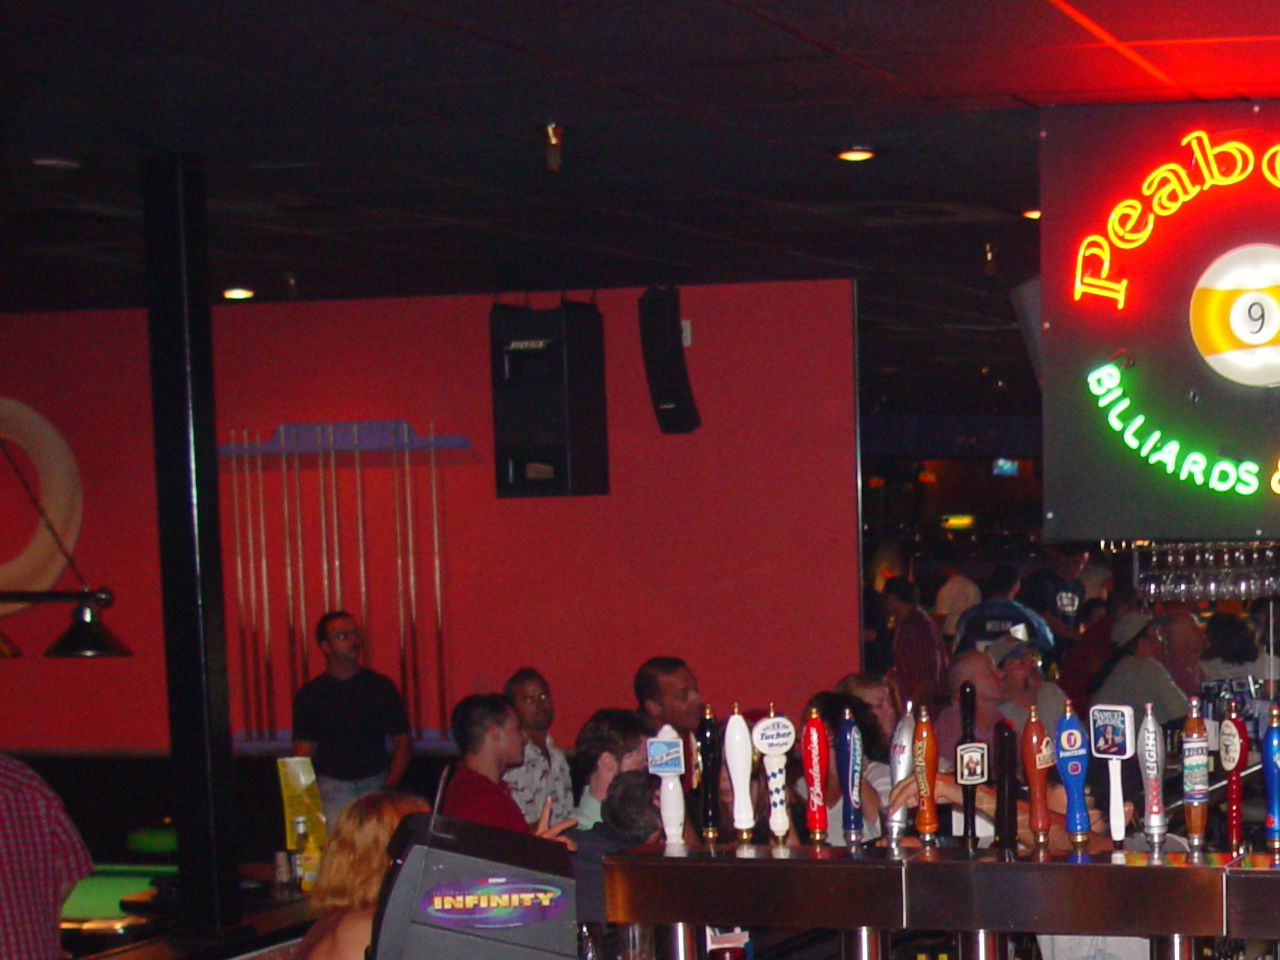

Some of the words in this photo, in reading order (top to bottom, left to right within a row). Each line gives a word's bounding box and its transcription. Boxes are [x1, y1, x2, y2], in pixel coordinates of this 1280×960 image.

[1246, 301, 1267, 335] 9
[1087, 364, 1260, 494] BILLIARDS
[808, 727, 824, 811] Budweiser
[1144, 728, 1158, 776] LIGHT
[433, 892, 555, 910] INFINITY
